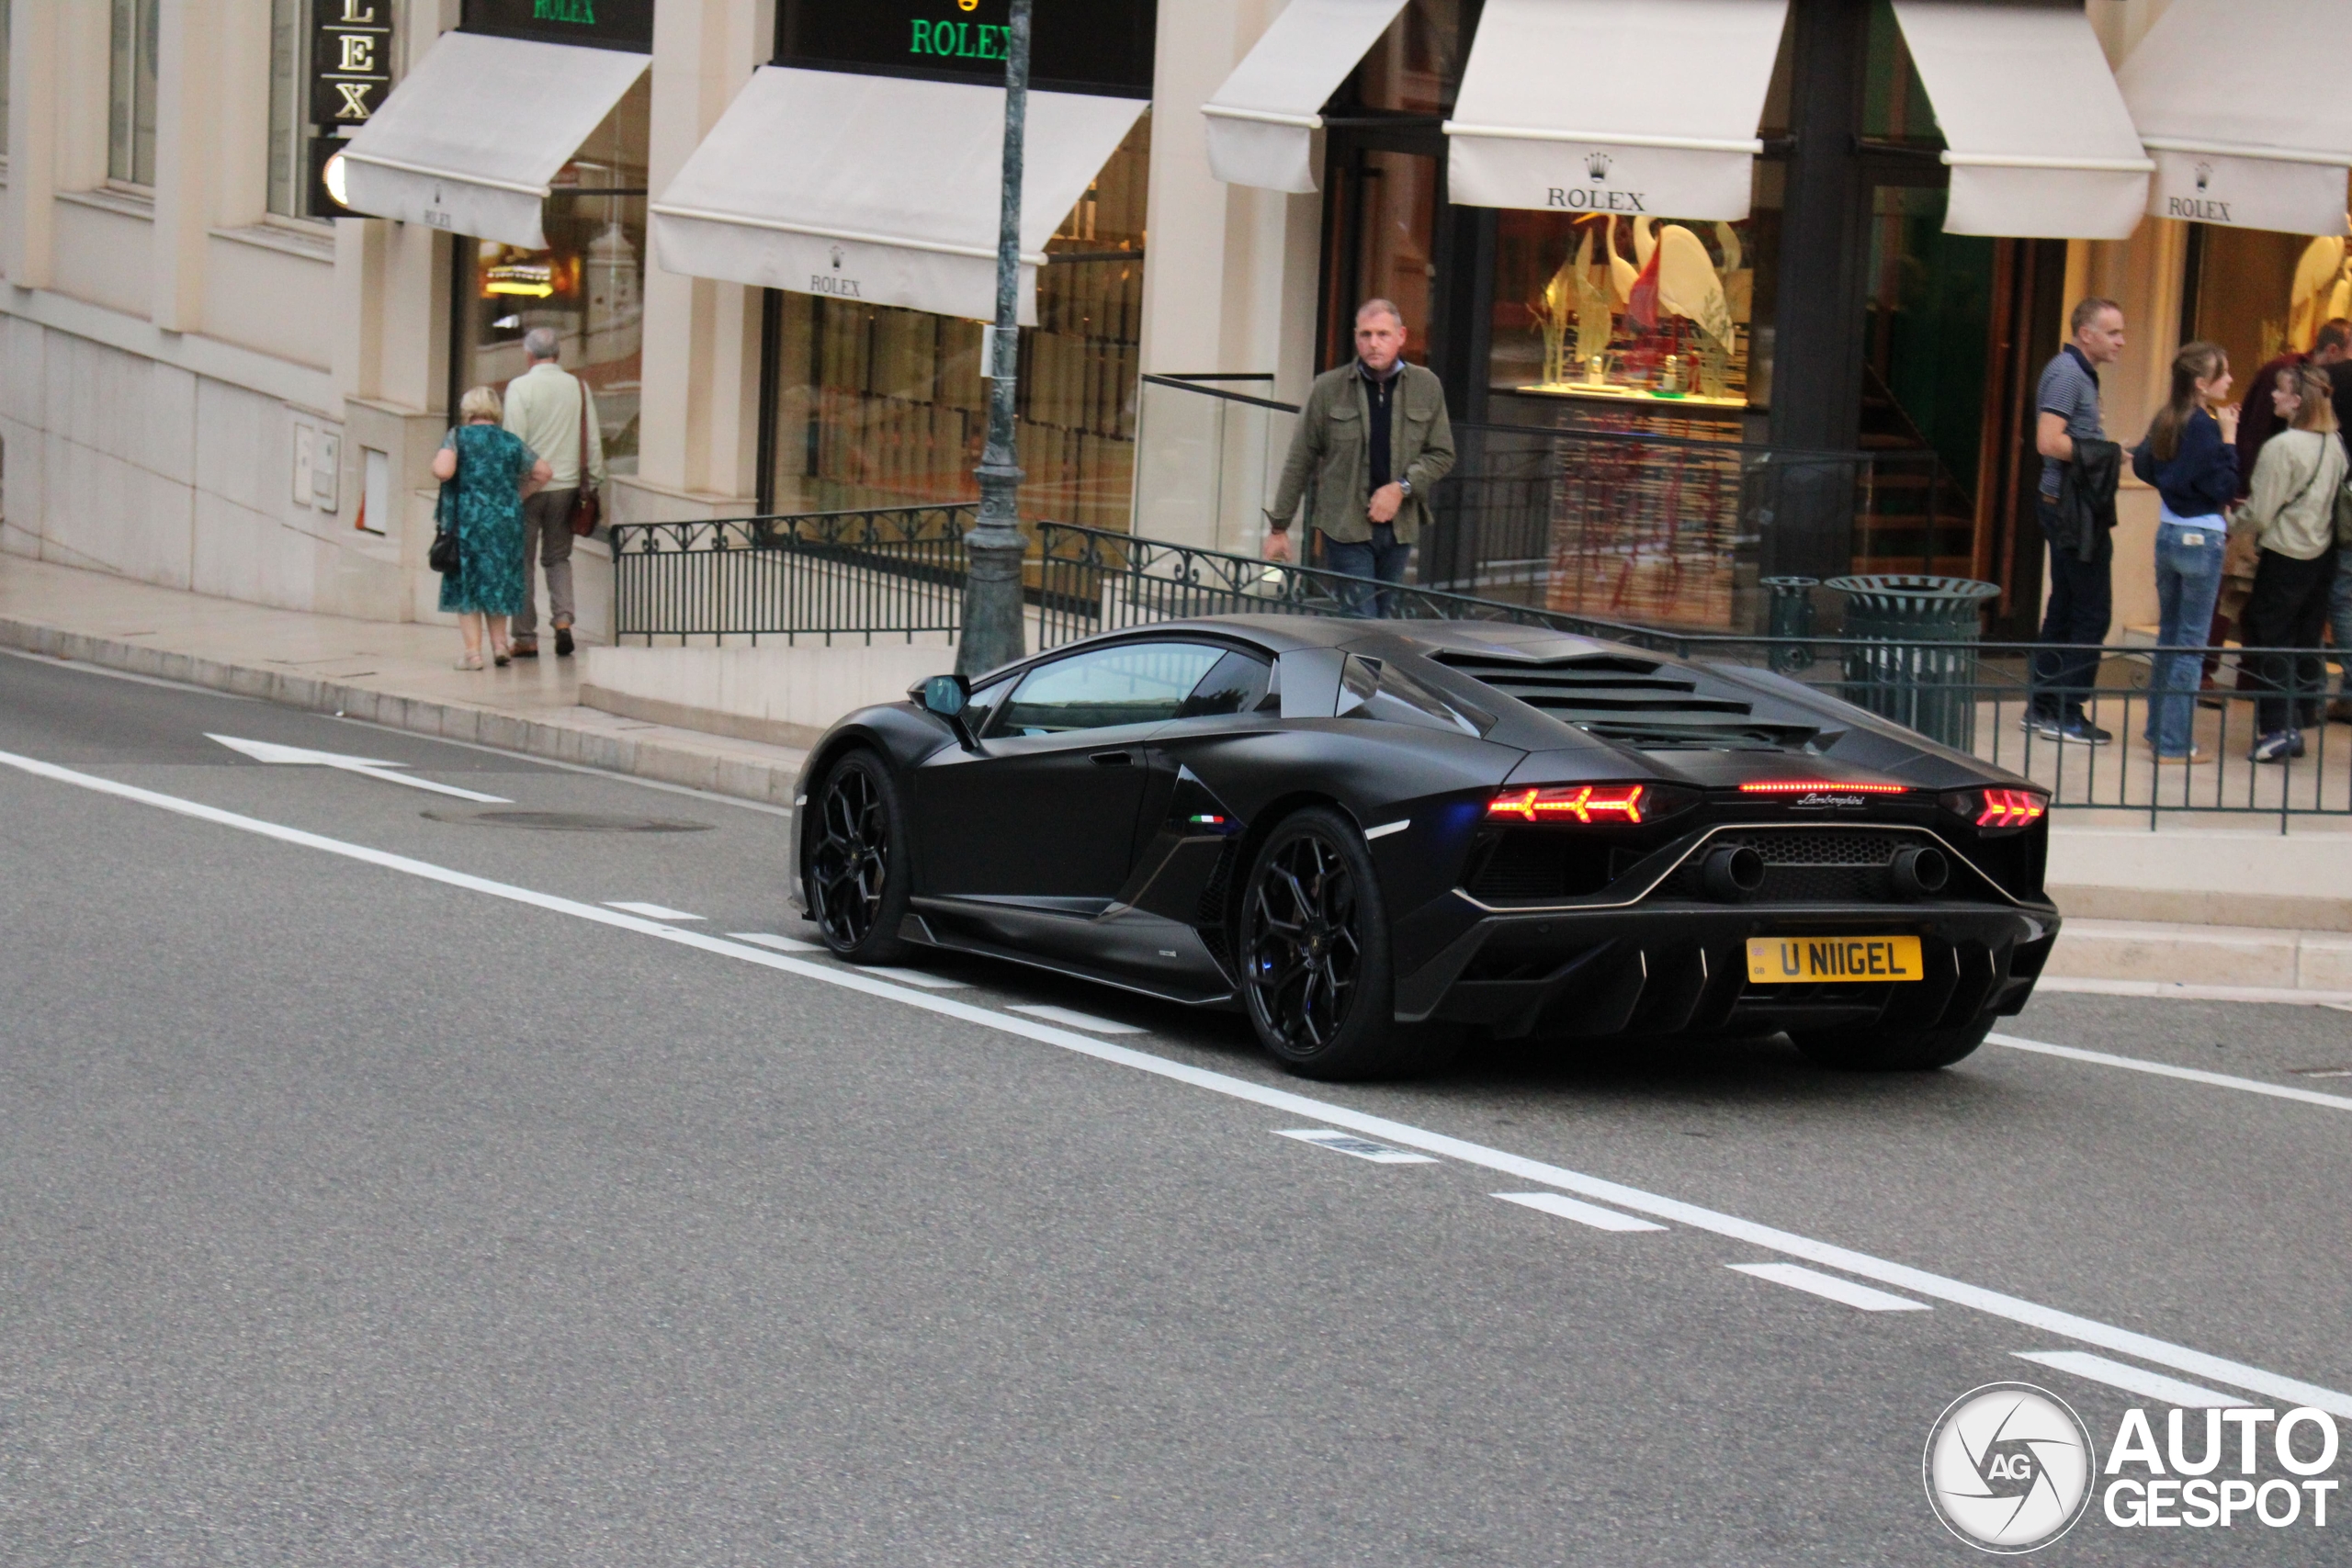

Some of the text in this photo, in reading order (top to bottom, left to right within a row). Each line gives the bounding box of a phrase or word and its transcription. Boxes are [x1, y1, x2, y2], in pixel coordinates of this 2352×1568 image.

[1546, 187, 1645, 212] ROLEX
[2168, 197, 2232, 221] ROLEX
[809, 275, 861, 297] ROLEX
[1796, 793, 1866, 807] Lamborghini
[1754, 966, 1765, 975] GB
[1781, 942, 1801, 976] U
